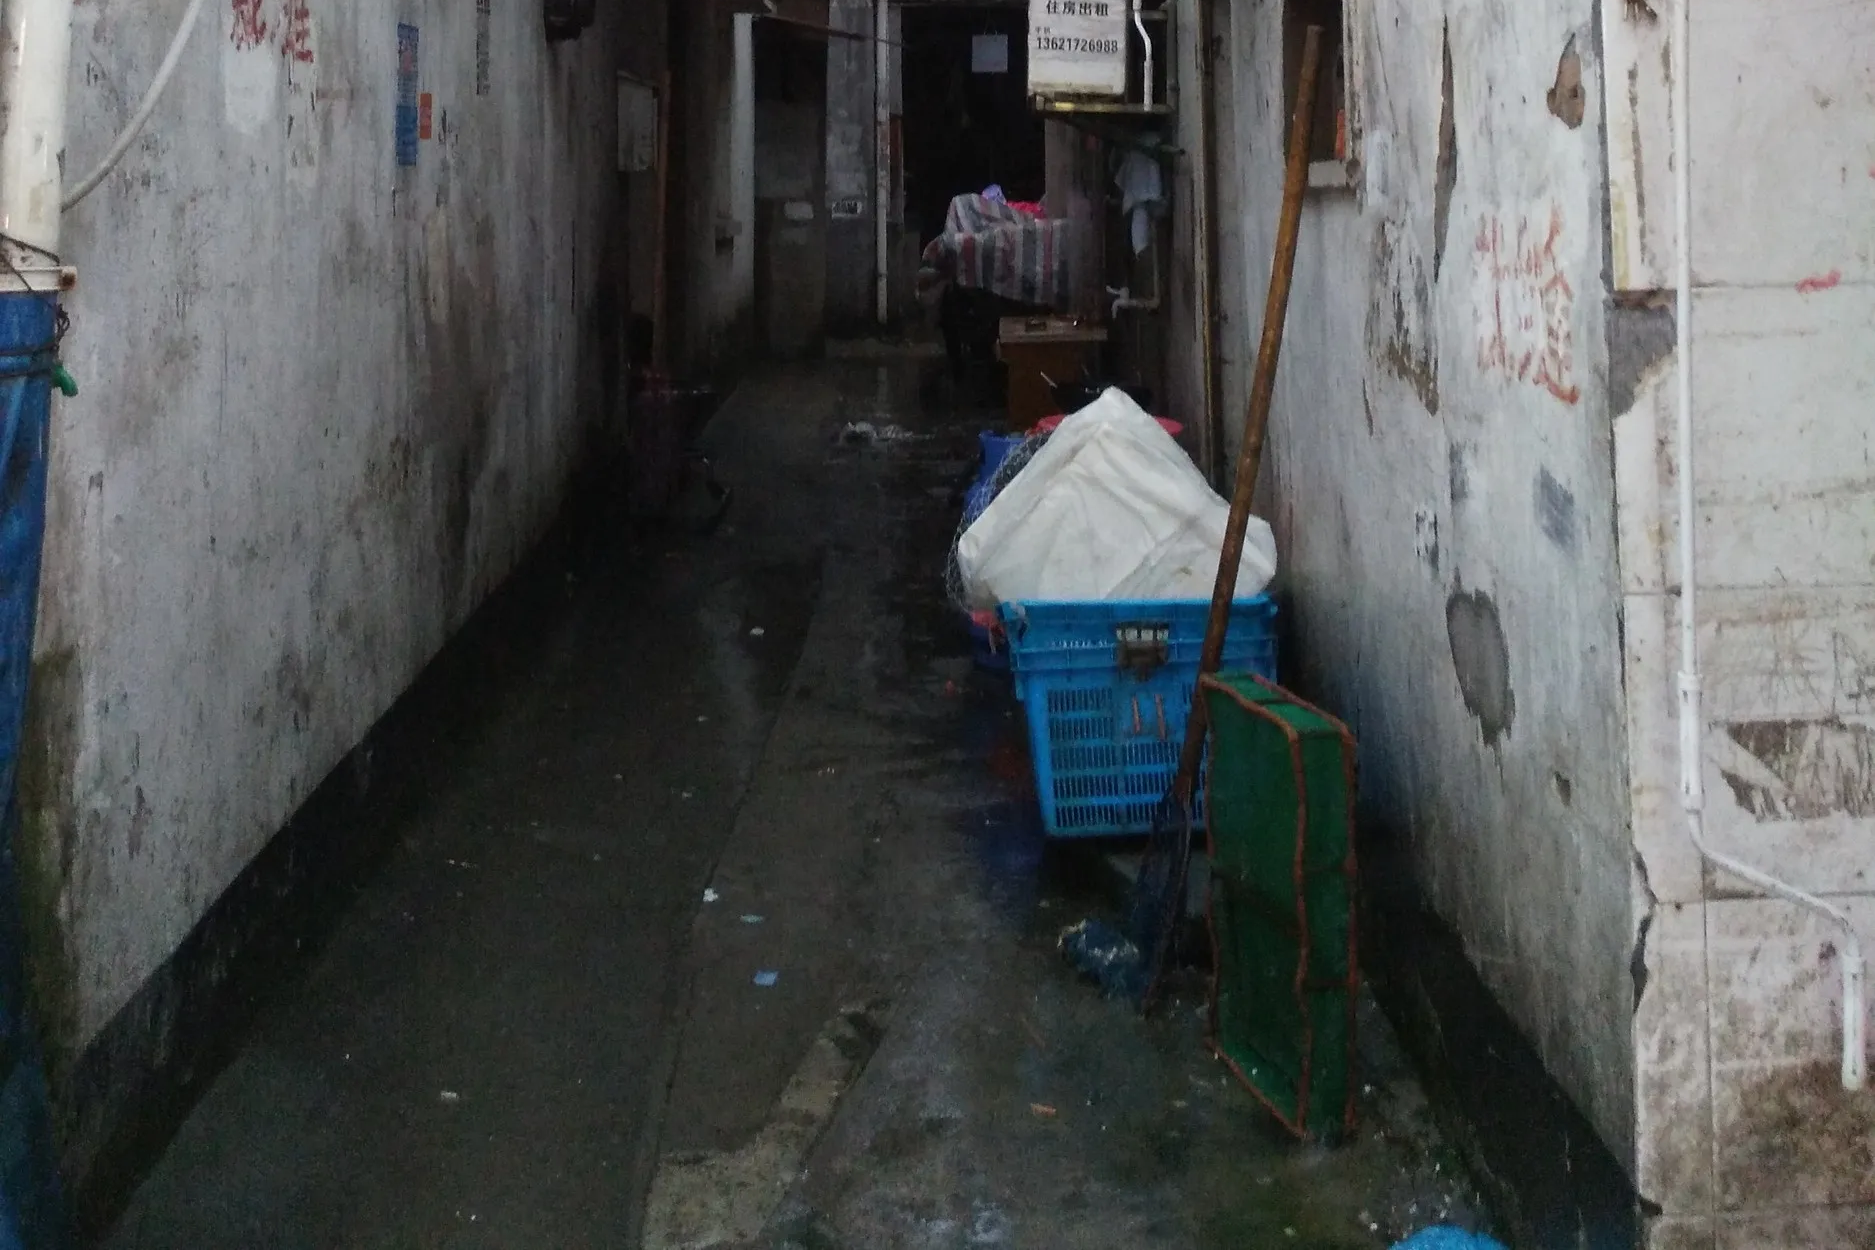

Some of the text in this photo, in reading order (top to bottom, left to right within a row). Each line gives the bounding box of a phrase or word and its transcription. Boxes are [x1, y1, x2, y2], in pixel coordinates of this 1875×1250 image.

[1046, 0, 1108, 16] 住房出租
[1037, 37, 1118, 53] 13621726988
